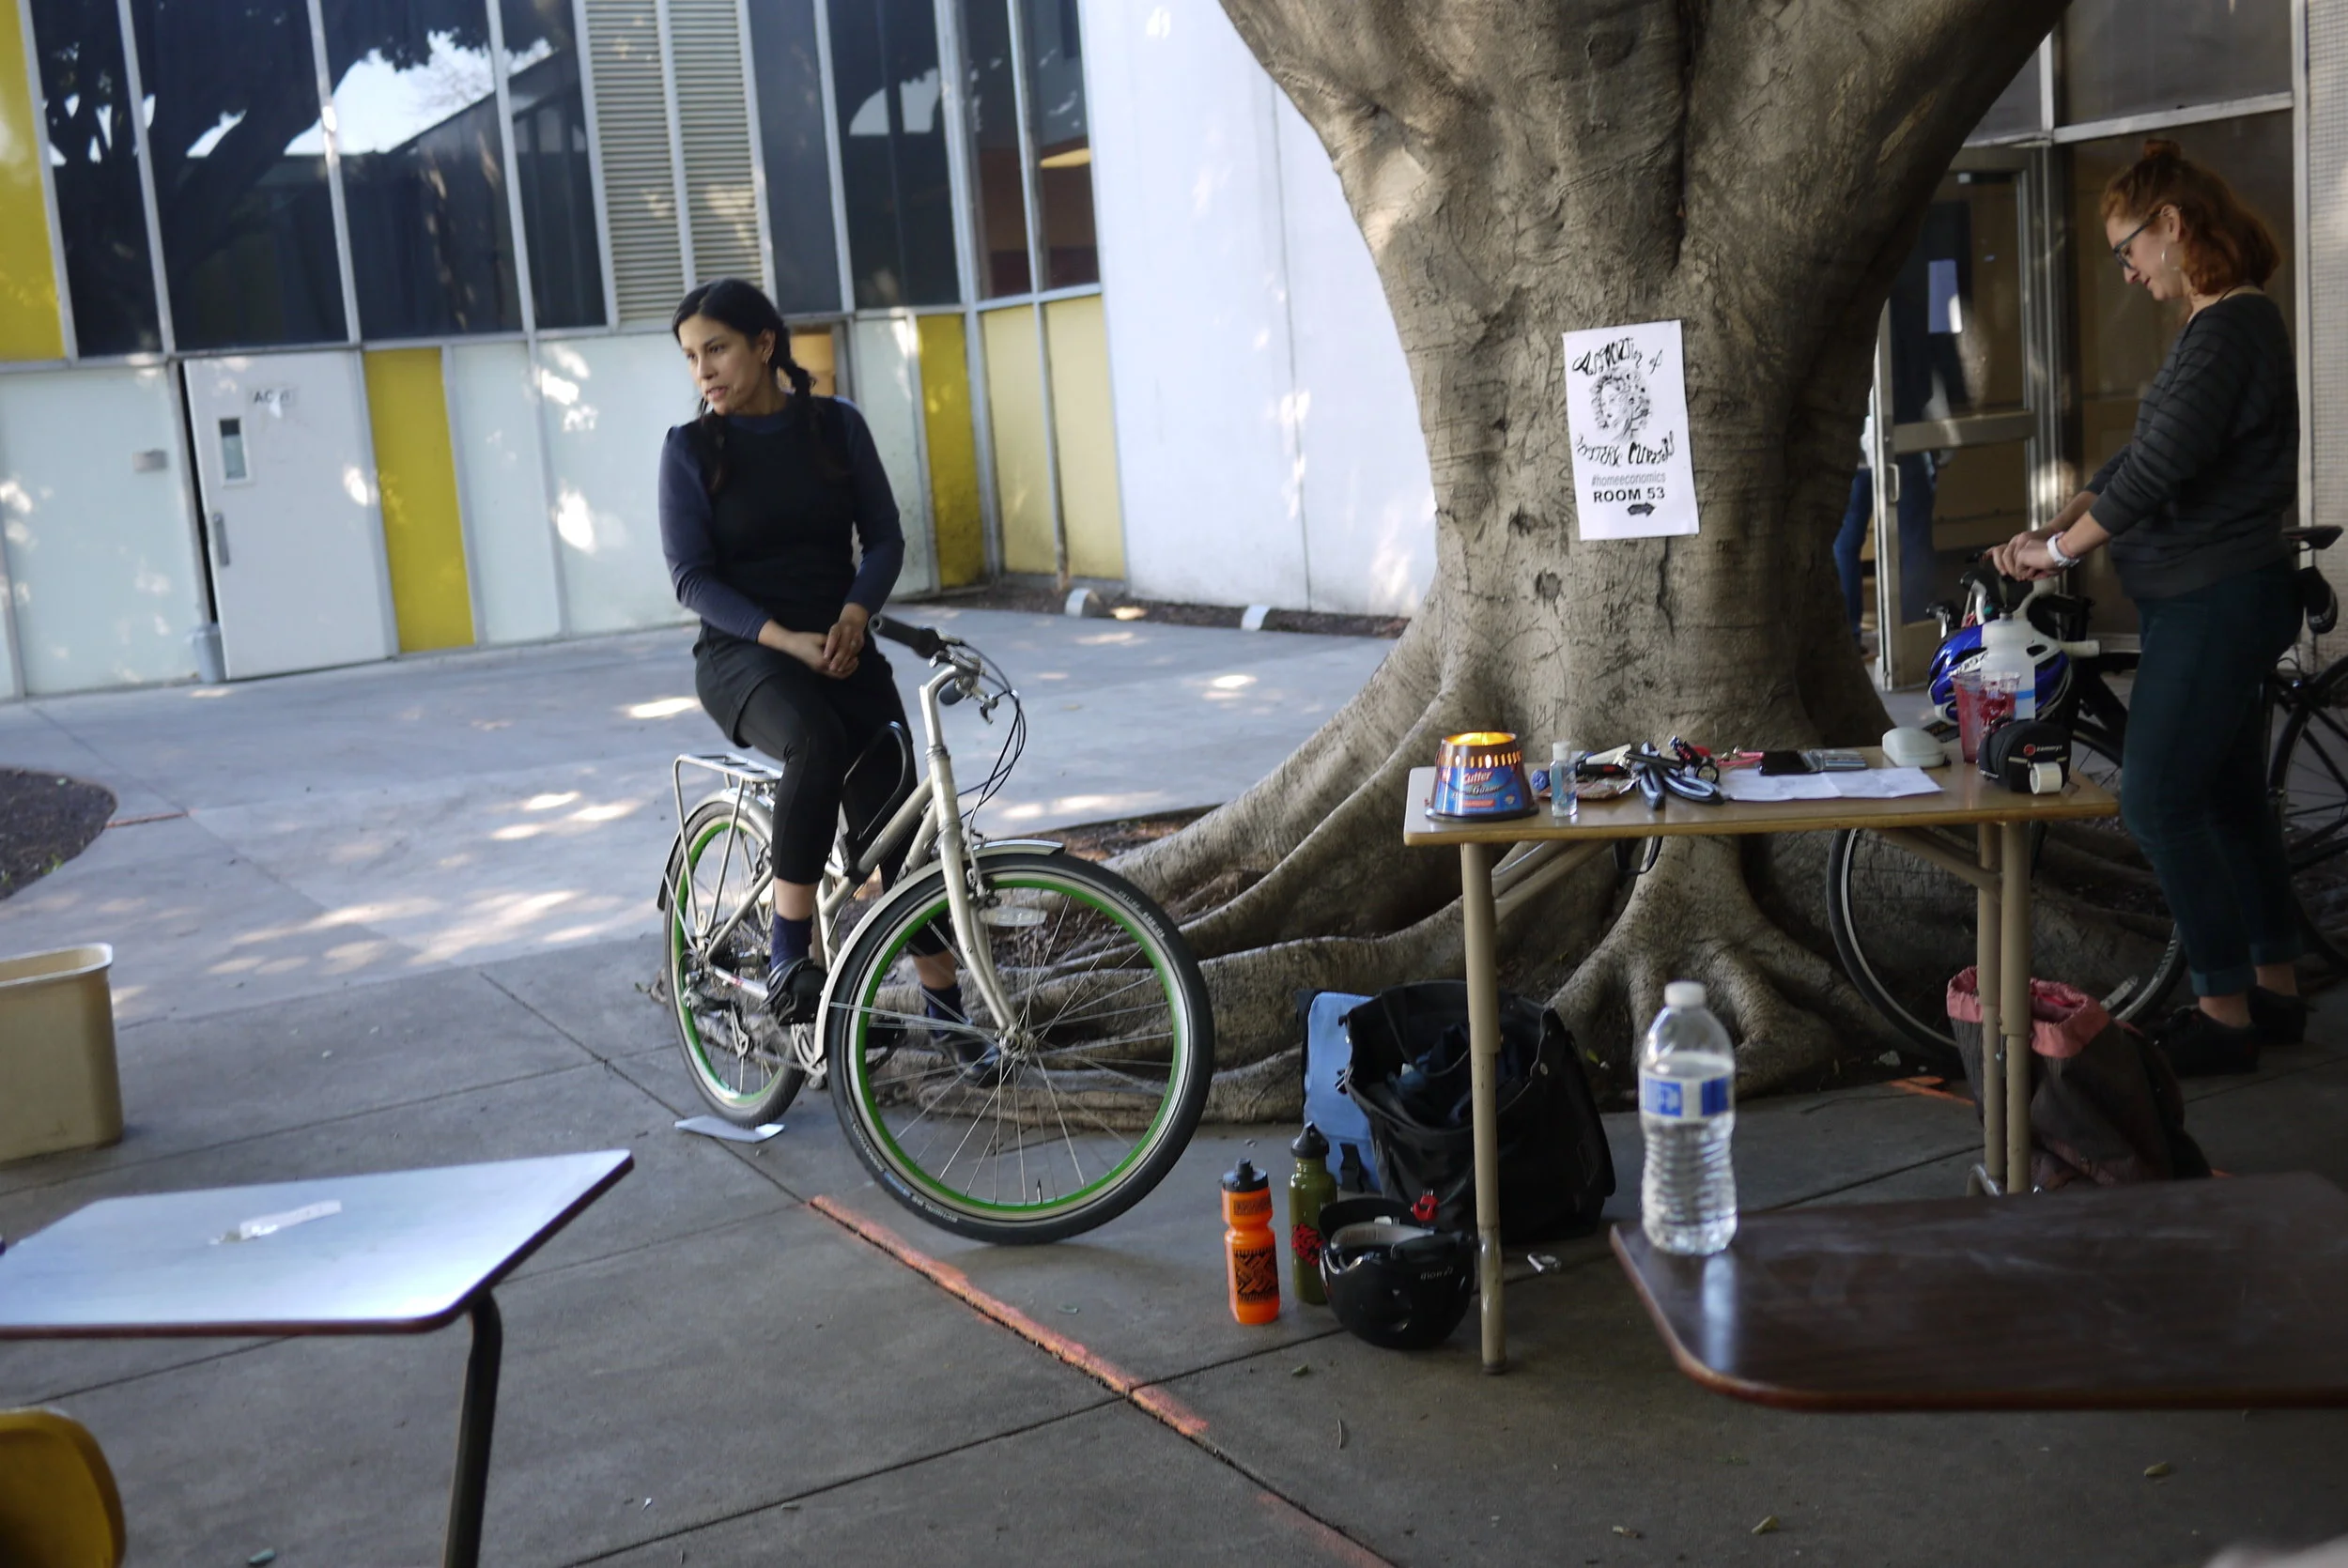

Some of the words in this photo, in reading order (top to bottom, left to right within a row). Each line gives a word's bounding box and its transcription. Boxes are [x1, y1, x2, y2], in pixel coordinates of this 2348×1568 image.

[1591, 470, 1666, 487] #homeeconomics
[1594, 488, 1641, 503] ROOM
[1647, 486, 1665, 500] 53
